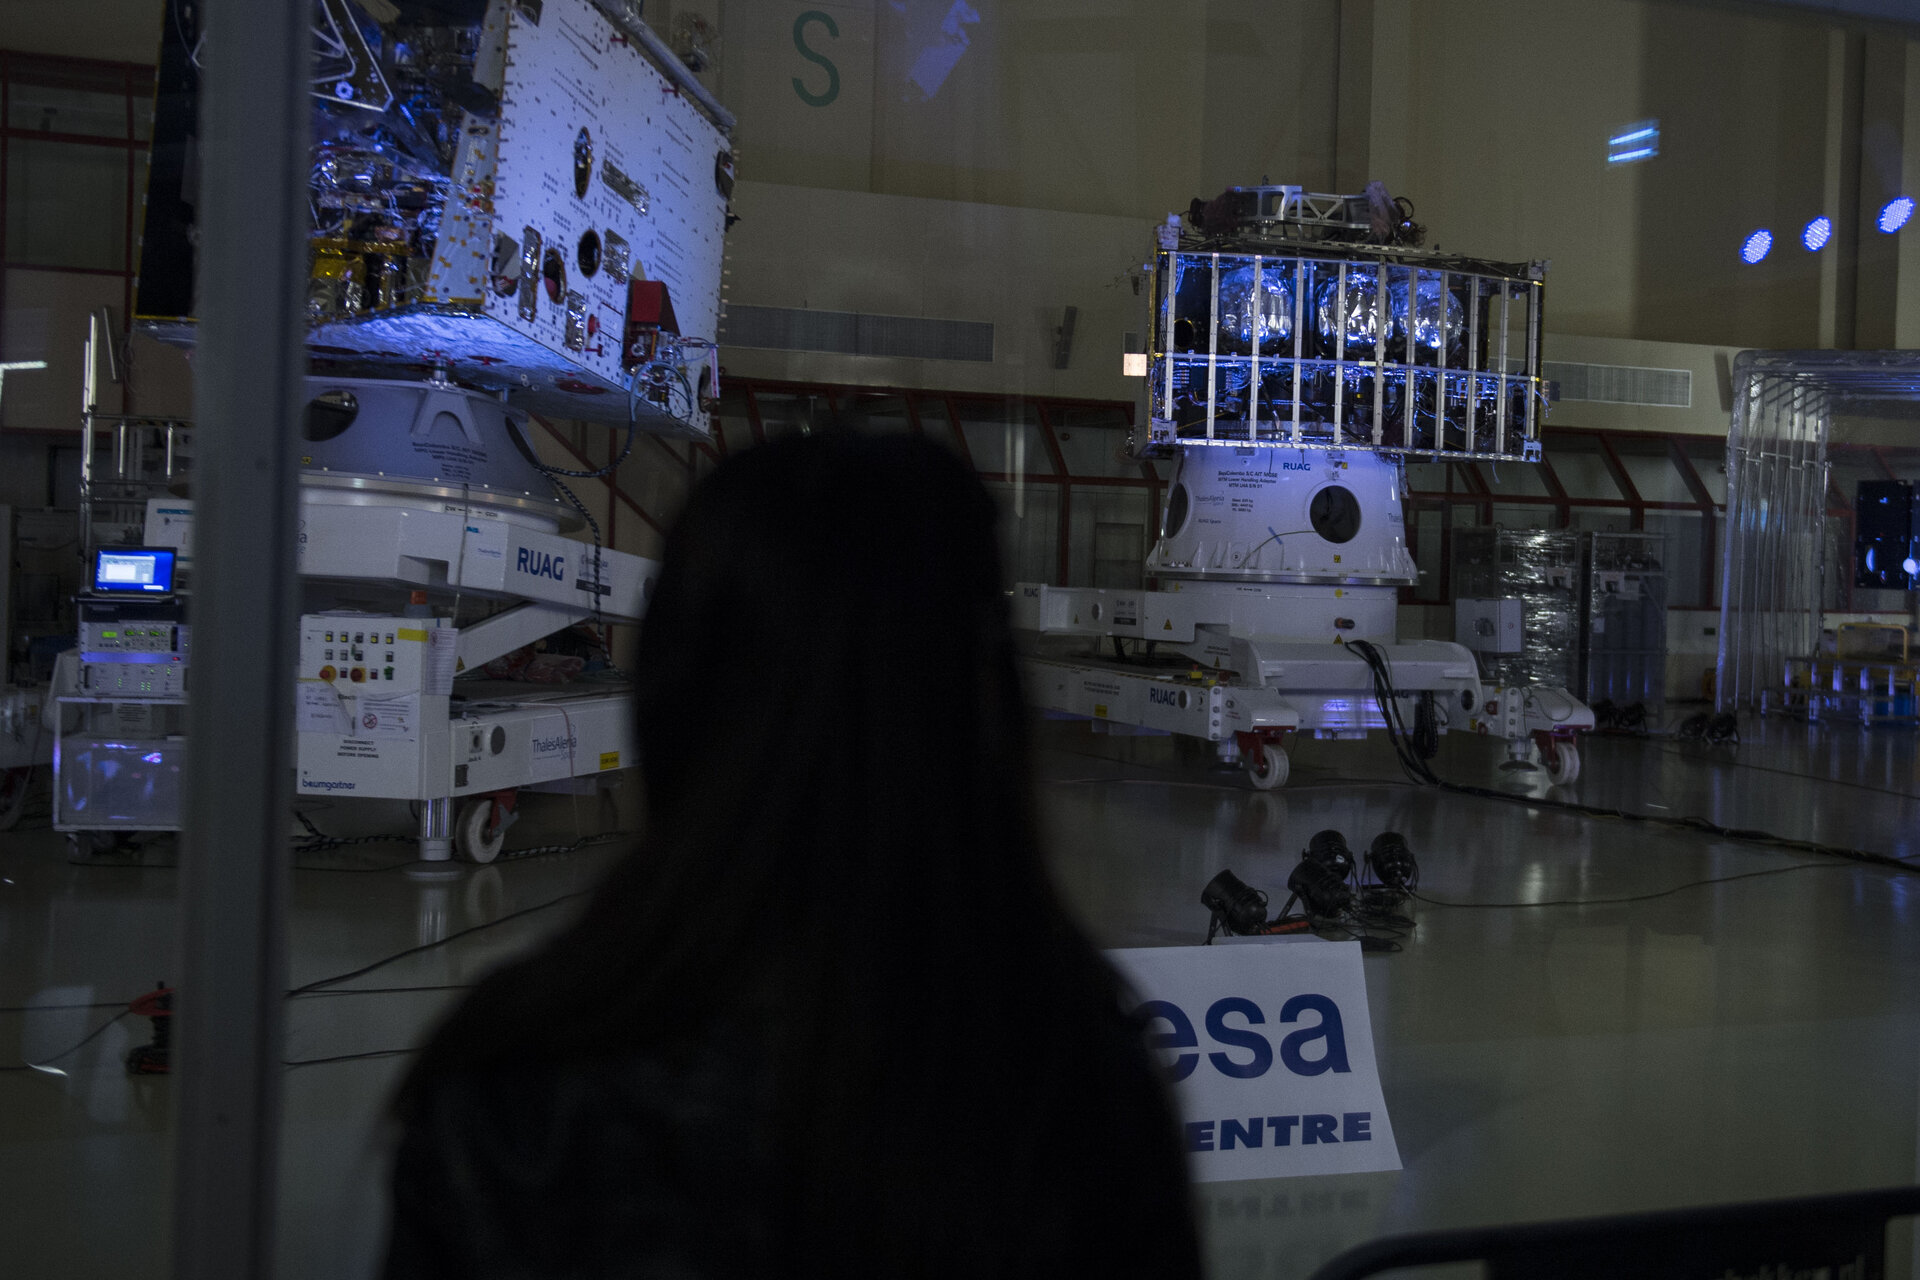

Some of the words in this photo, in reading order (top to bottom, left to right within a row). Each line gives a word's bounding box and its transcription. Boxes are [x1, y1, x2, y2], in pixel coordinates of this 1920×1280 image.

[792, 10, 840, 107] S
[1282, 462, 1311, 471] RUAG
[517, 547, 565, 581] RUAG
[1150, 687, 1176, 706] RUAG
[532, 735, 577, 753] ThalesAlenia
[302, 779, 356, 791] baumgartner
[1133, 993, 1352, 1084] esa
[1185, 1112, 1372, 1152] ENTRE
